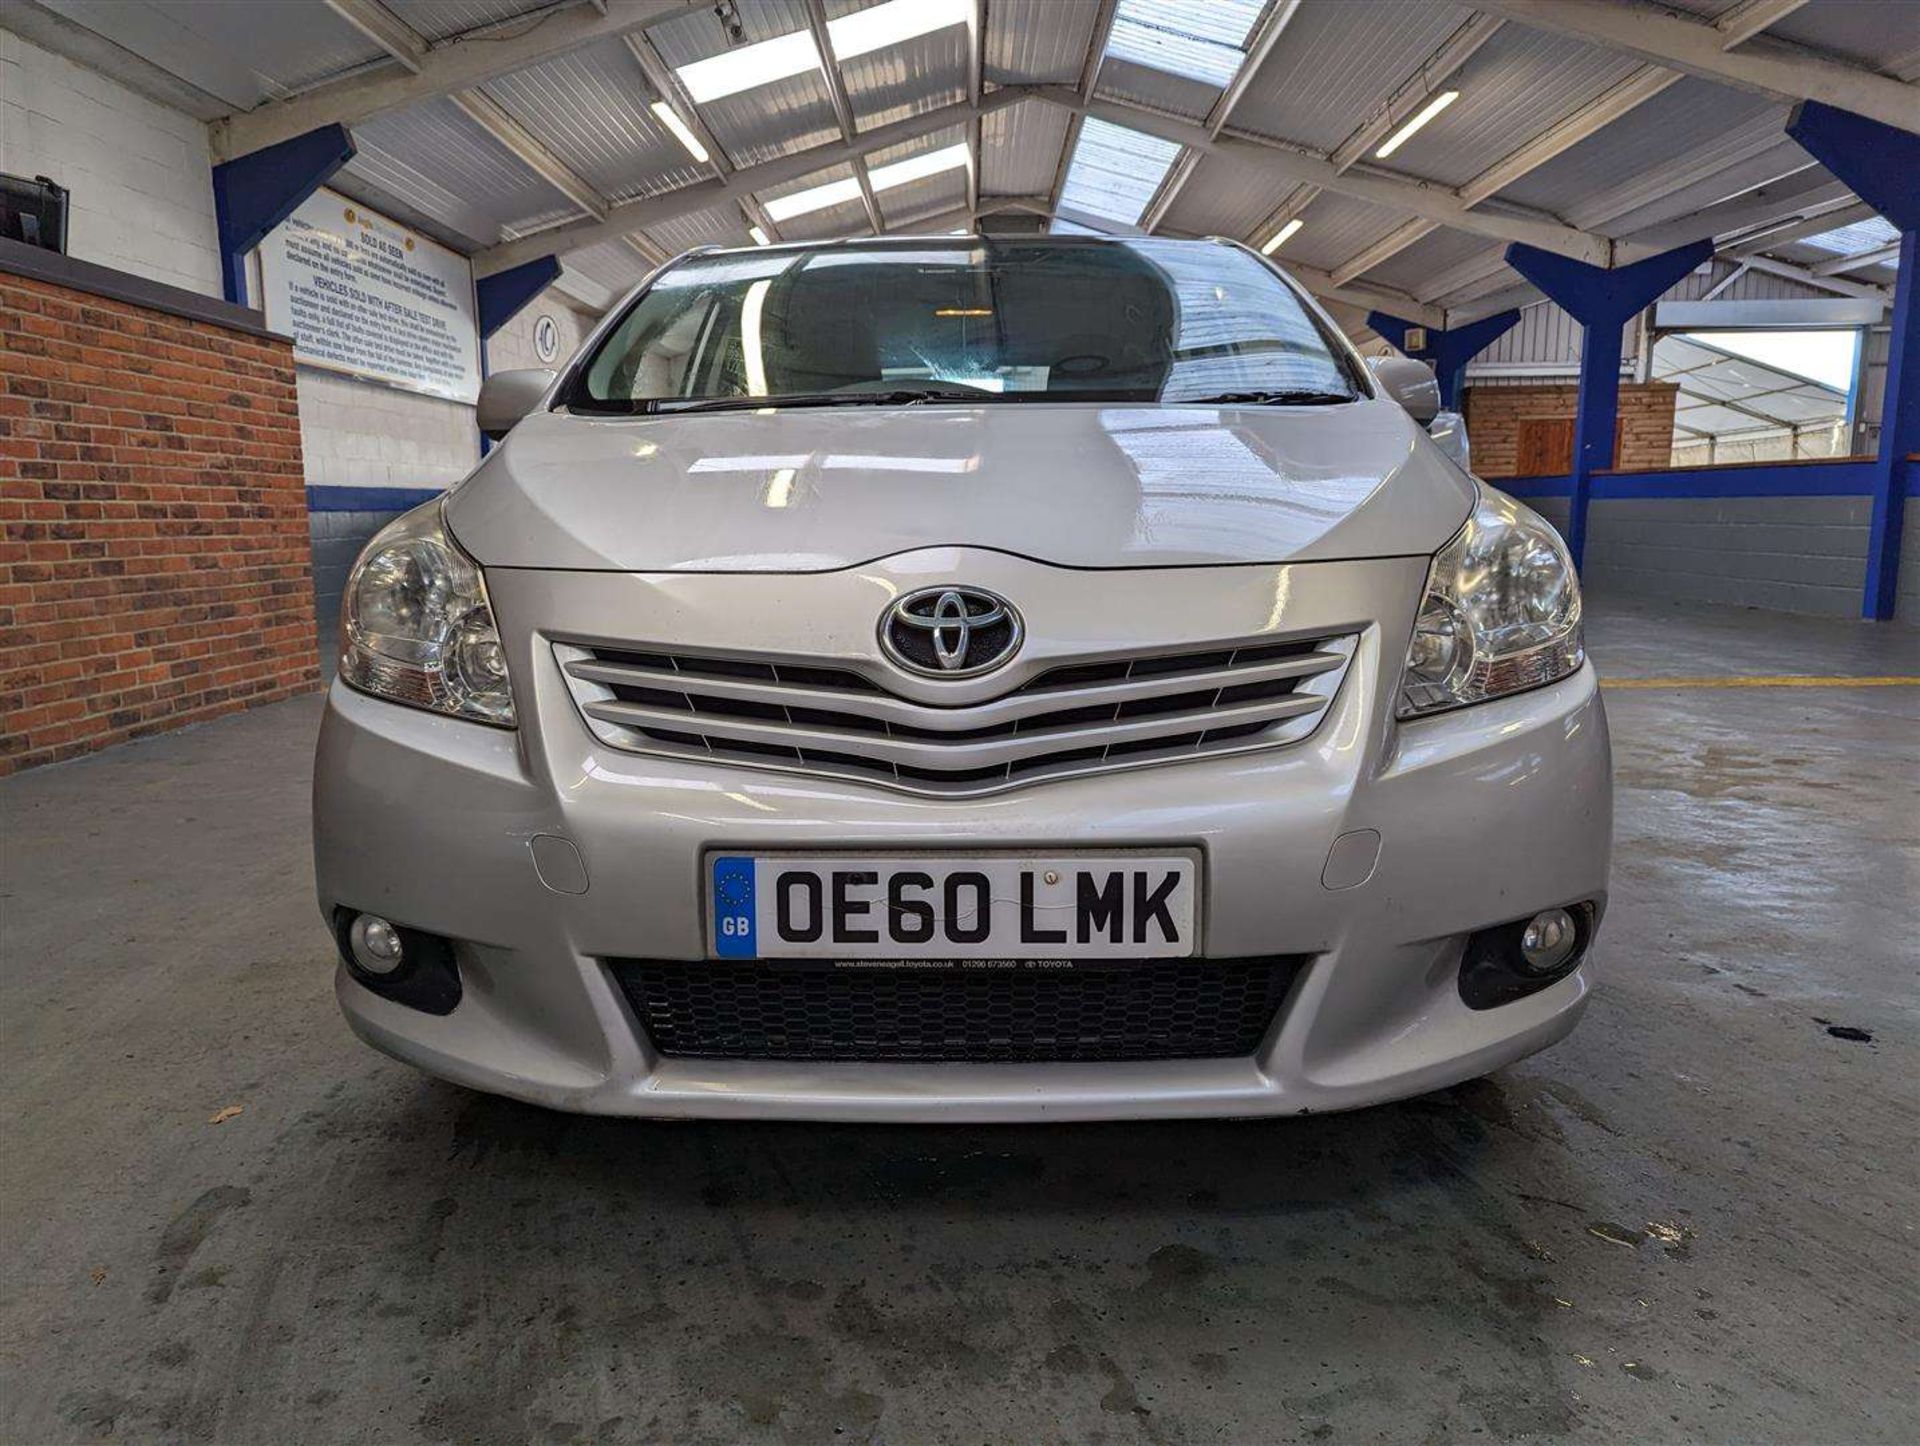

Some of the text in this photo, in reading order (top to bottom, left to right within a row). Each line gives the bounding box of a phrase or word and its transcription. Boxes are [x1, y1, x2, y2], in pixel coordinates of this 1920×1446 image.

[776, 871, 1182, 944] OE60 LMK
[722, 917, 750, 936] GB
[1037, 960, 1074, 969] TOYOTA
